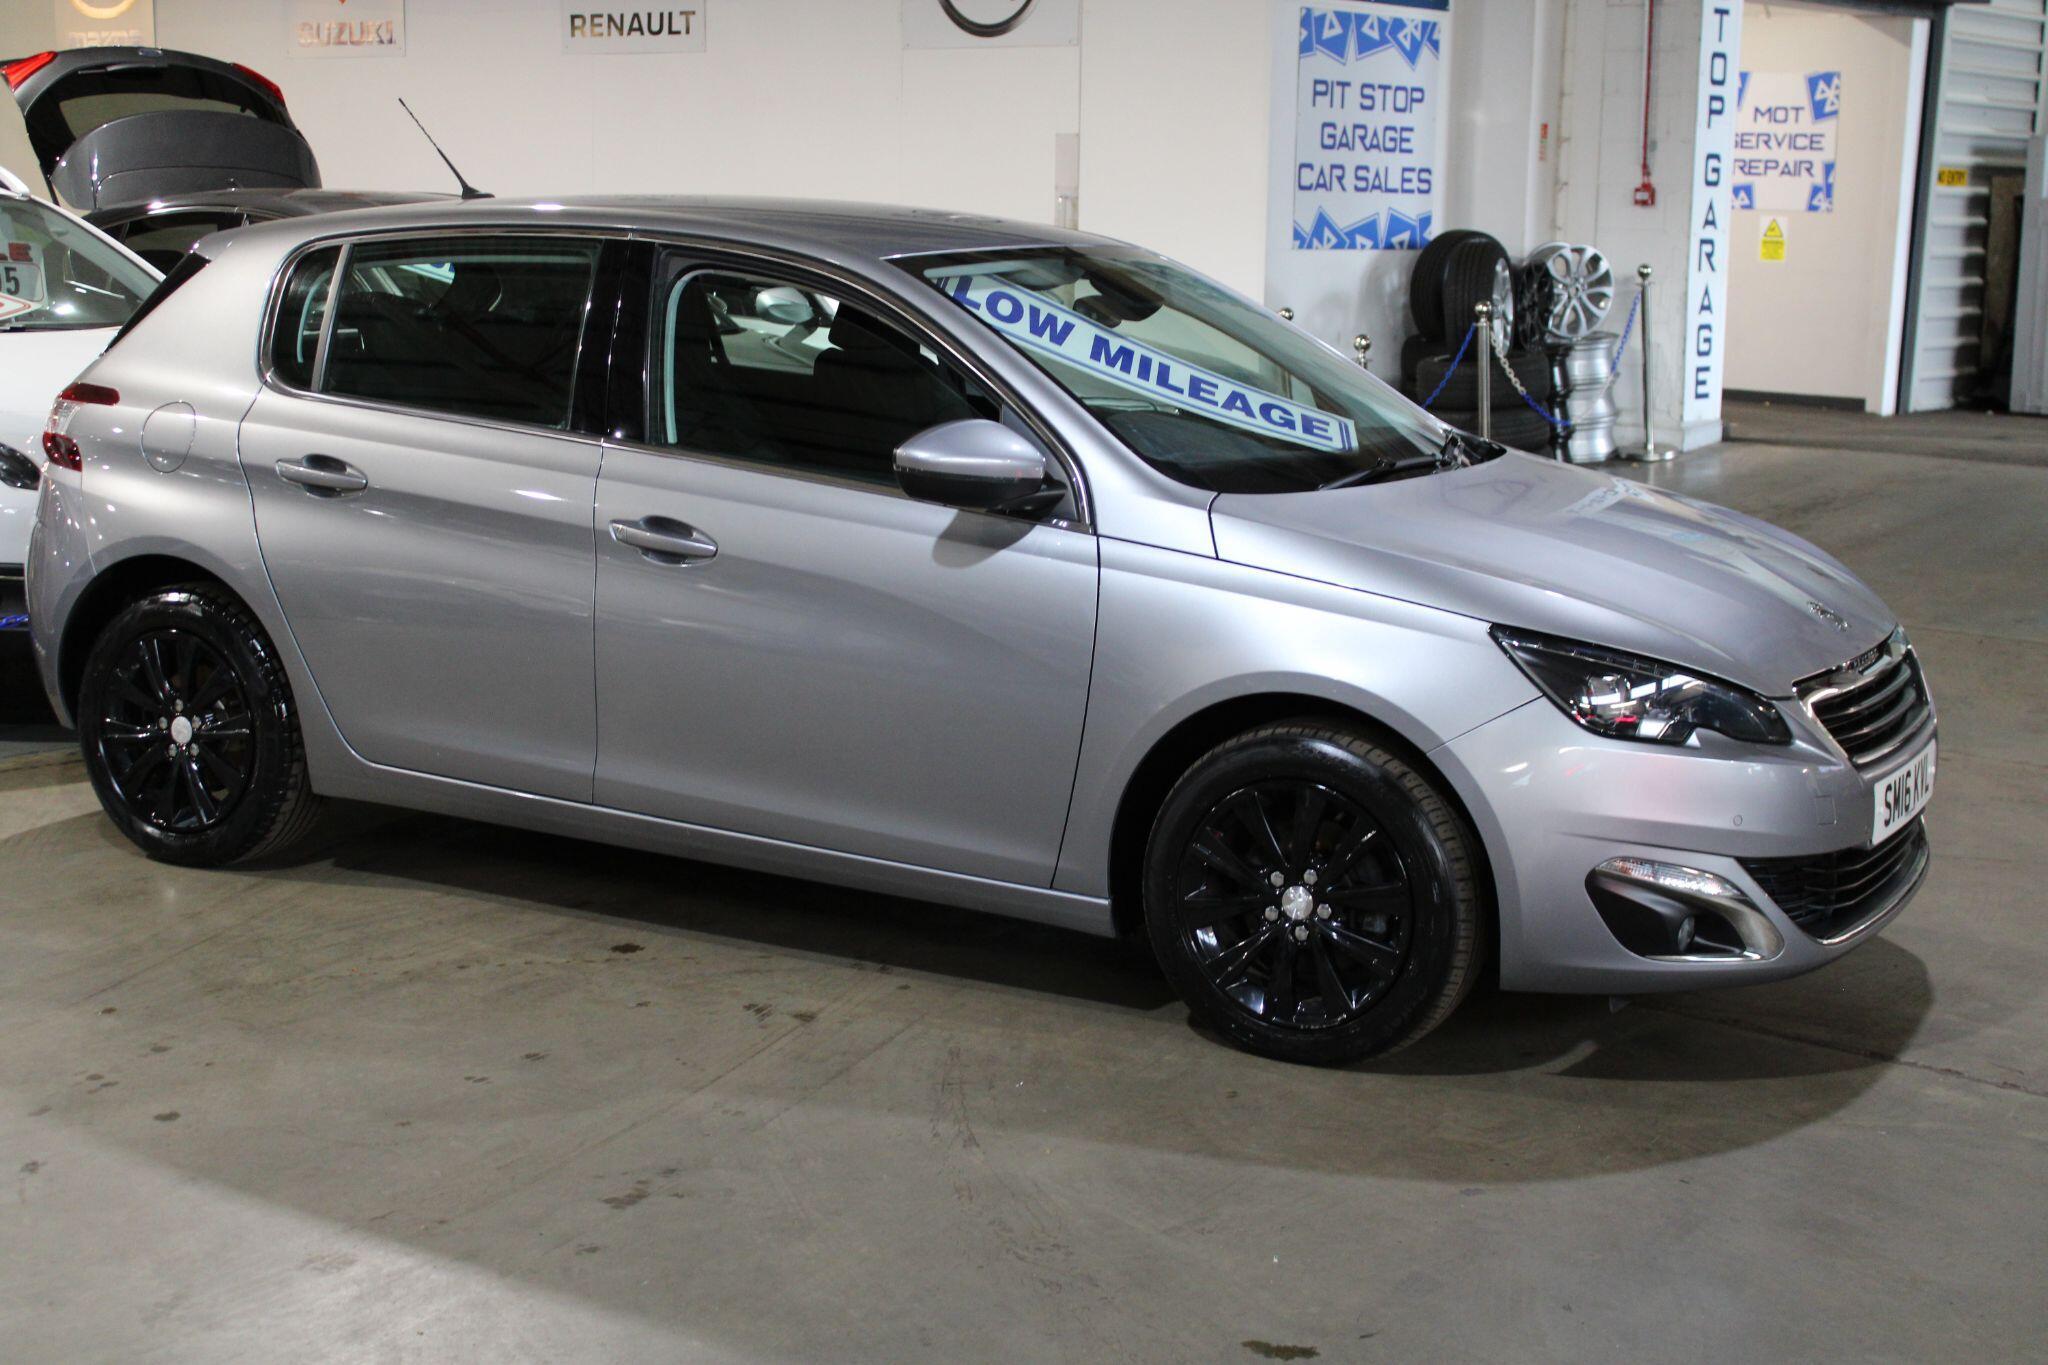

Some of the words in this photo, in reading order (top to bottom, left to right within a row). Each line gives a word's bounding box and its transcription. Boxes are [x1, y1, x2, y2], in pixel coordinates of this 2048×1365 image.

[298, 20, 396, 47] SUZUKI
[570, 10, 696, 38] RENAULT
[1312, 78, 1351, 109] PIT
[1359, 82, 1425, 113] STOP
[1753, 106, 1805, 124] MOT
[1320, 121, 1415, 154] GARAGE
[1297, 162, 1347, 192] CAR
[1353, 164, 1433, 195] SALES
[1733, 158, 1815, 177] REPAIR
[1694, 153, 1721, 400] GARAGE
[952, 272, 1076, 347] LOW
[1088, 332, 1335, 442] MILEAGE
